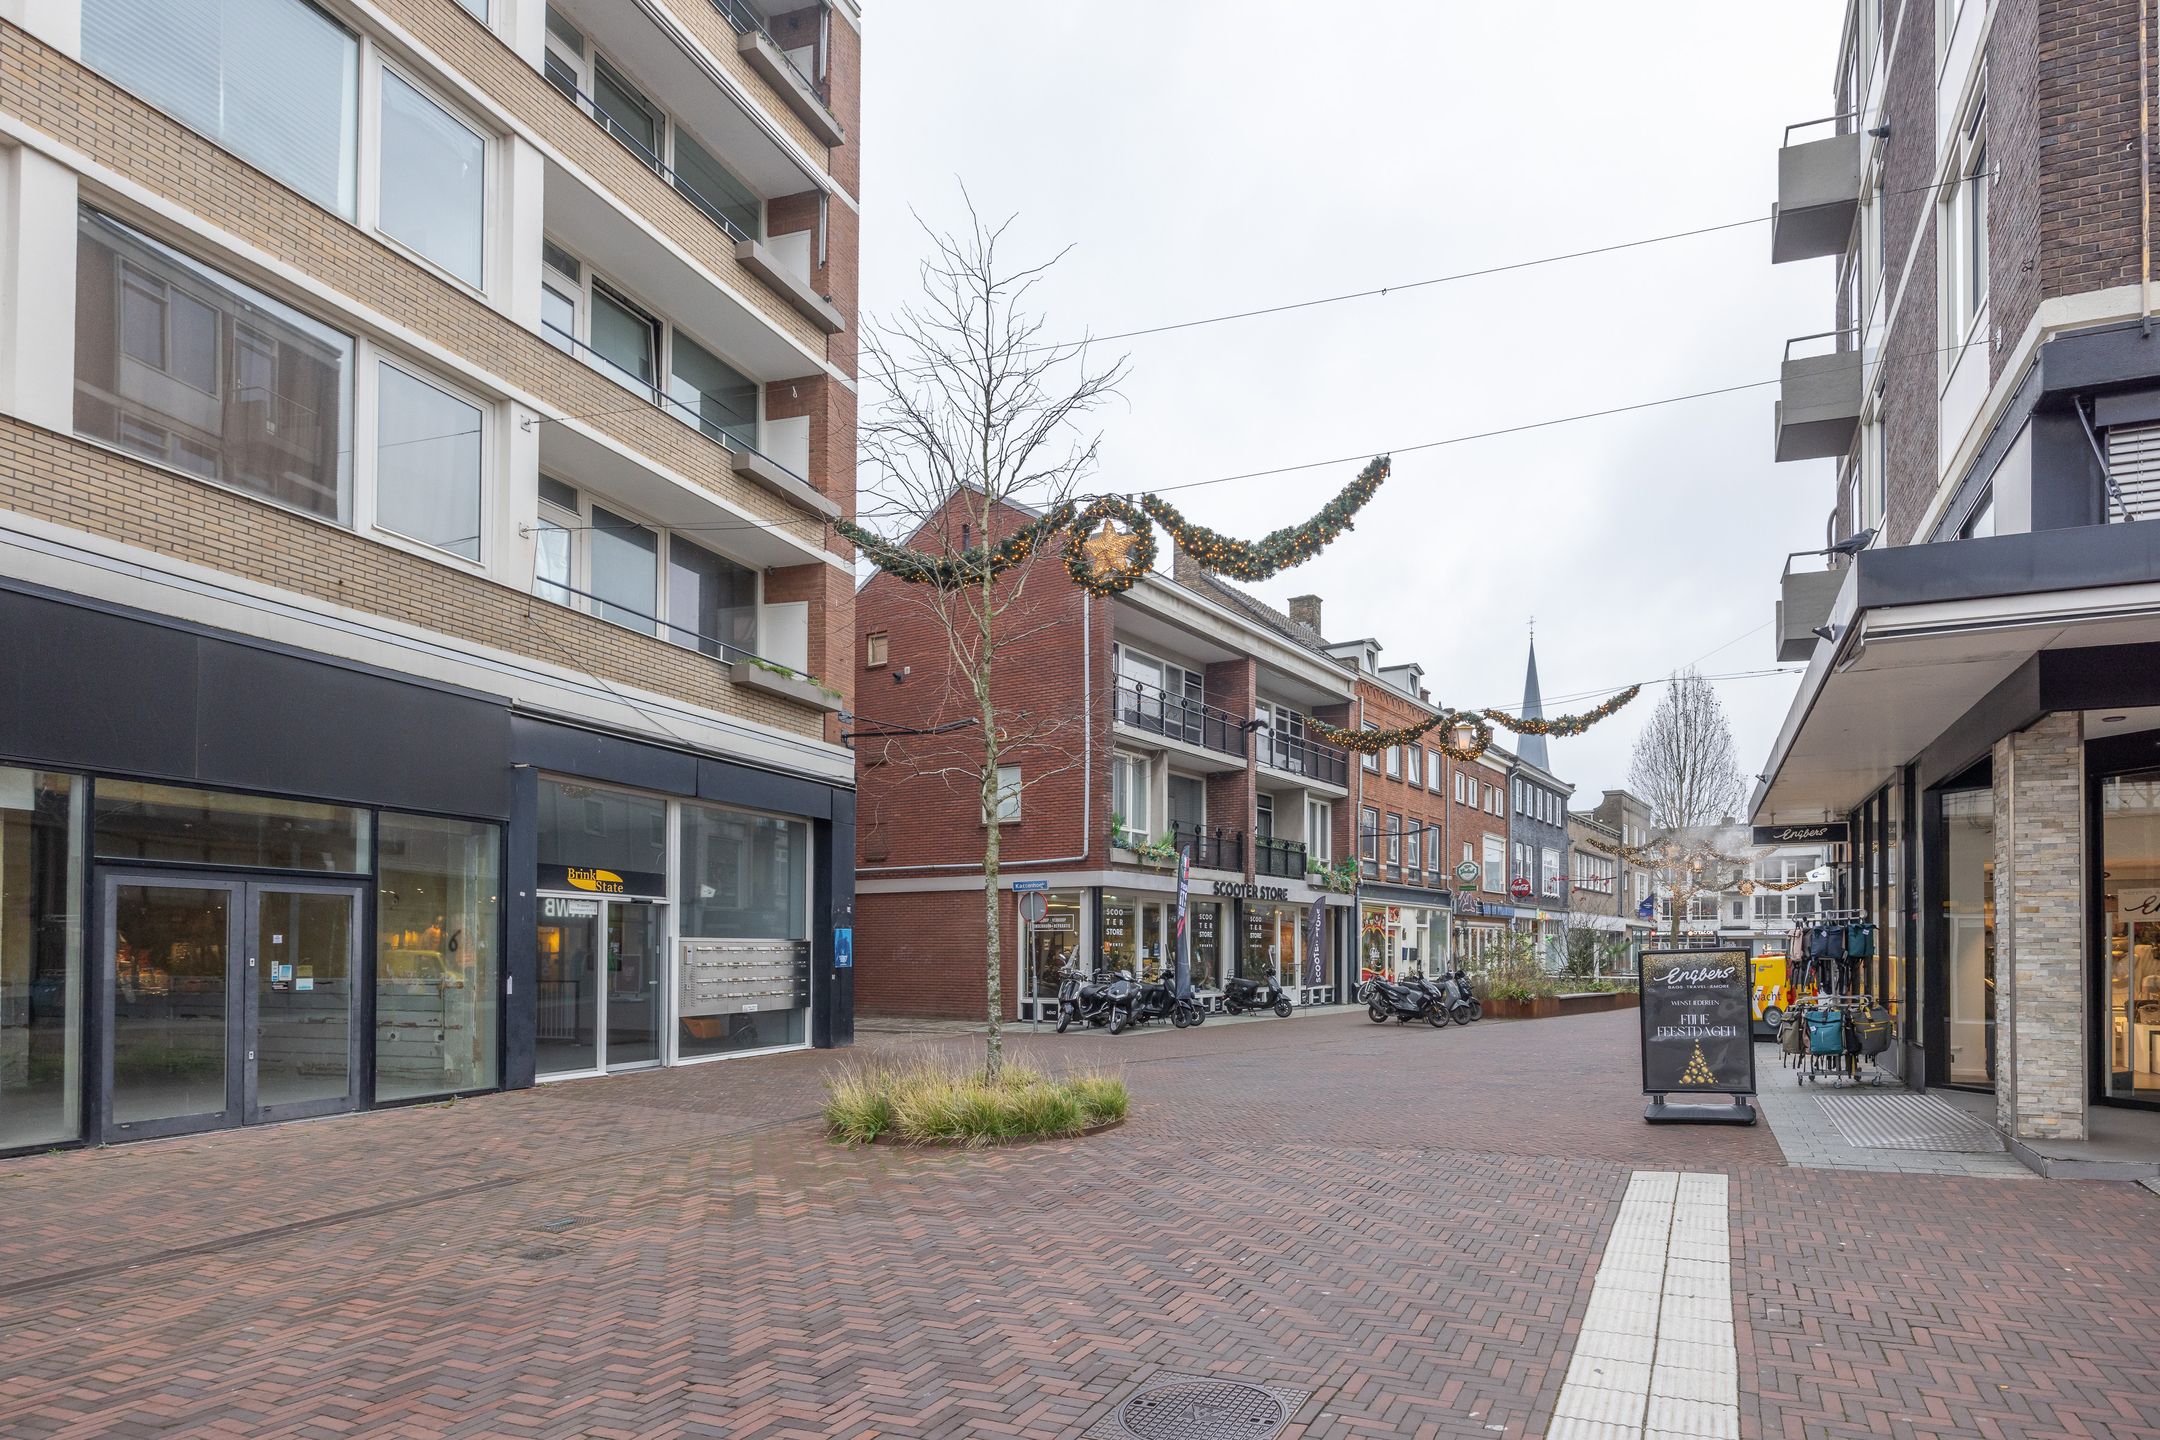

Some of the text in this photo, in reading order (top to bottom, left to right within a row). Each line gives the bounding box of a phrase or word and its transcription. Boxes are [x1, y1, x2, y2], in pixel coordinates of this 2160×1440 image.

[1773, 827, 1828, 840] Engbers
[567, 867, 596, 880] Brink
[595, 880, 624, 893] State
[1213, 881, 1288, 900] SCOOTER STORE
[1105, 908, 1123, 916] SCOO
[1105, 928, 1123, 936] STORE
[1653, 966, 1735, 985] Engbers
[1680, 1013, 1710, 1025] FIJNE
[1657, 1025, 1736, 1037] FEESTDAGEN
